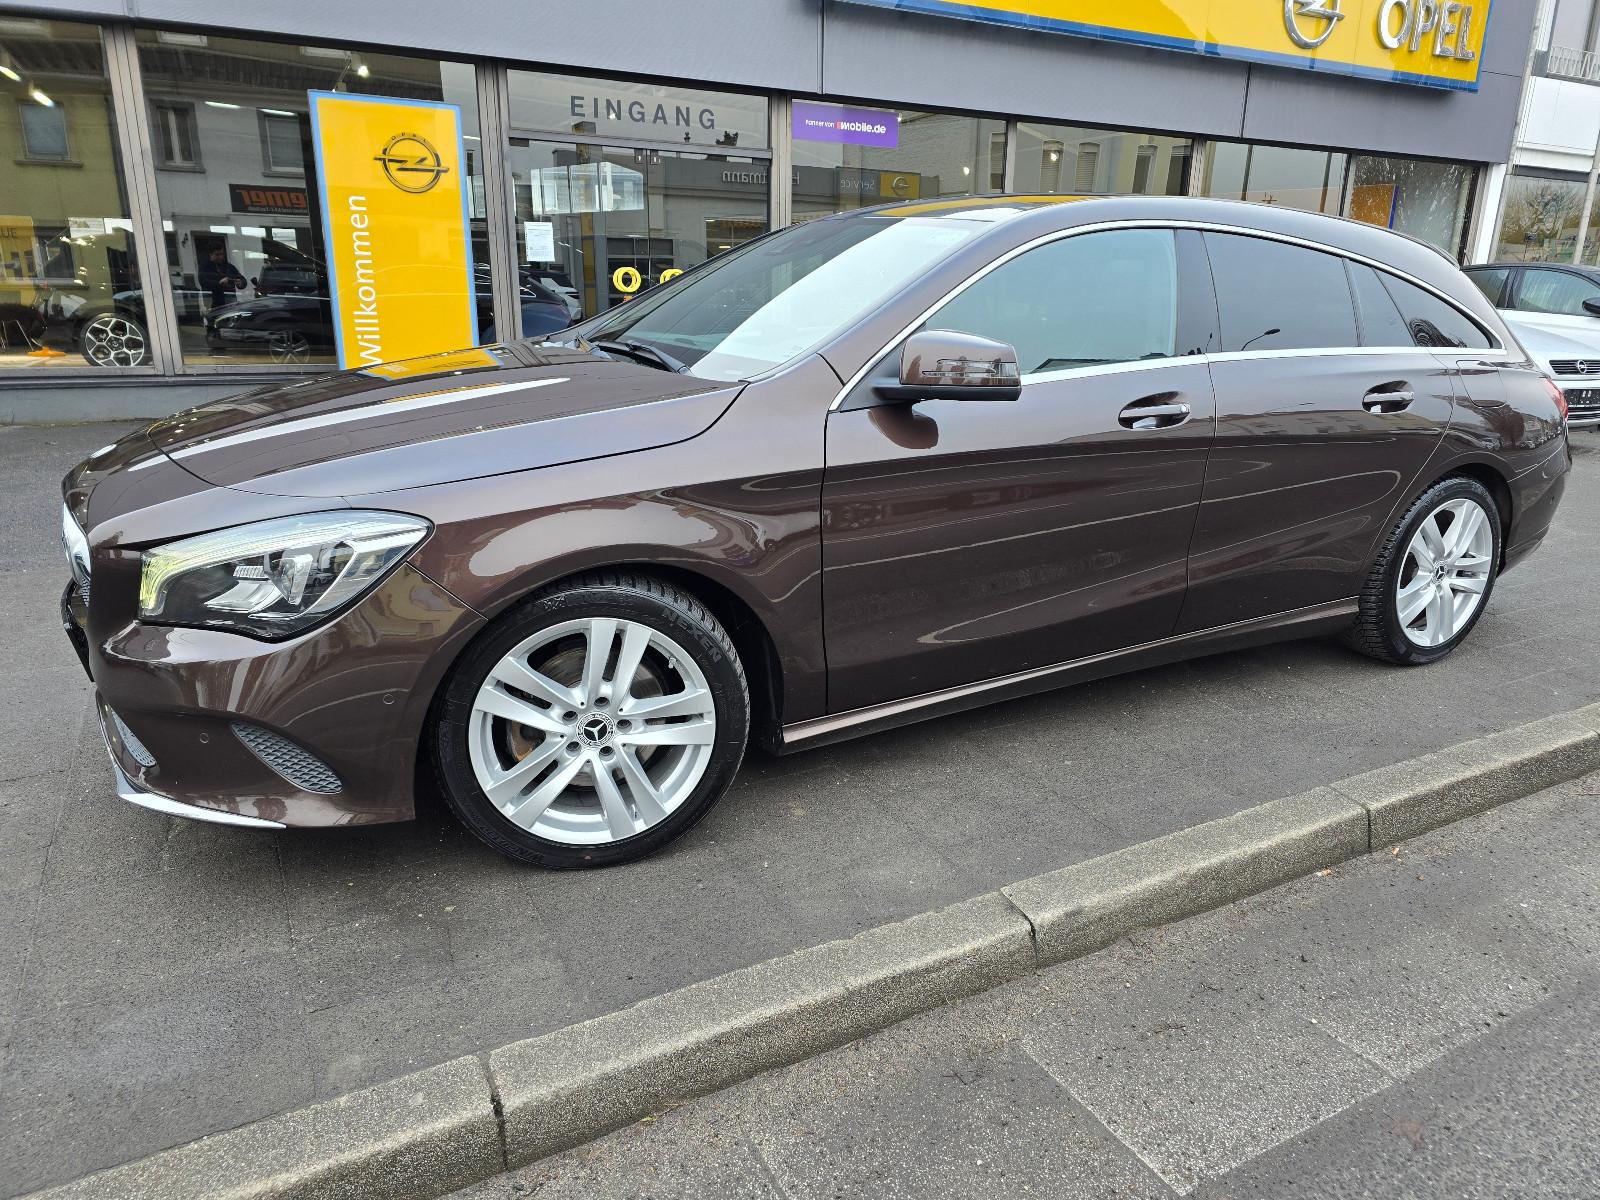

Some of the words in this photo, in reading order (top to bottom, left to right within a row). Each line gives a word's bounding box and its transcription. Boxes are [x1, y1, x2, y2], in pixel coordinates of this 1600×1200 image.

[1377, 0, 1475, 60] OPEL
[570, 95, 715, 129] EINGANG
[348, 195, 384, 367] Willkommen
